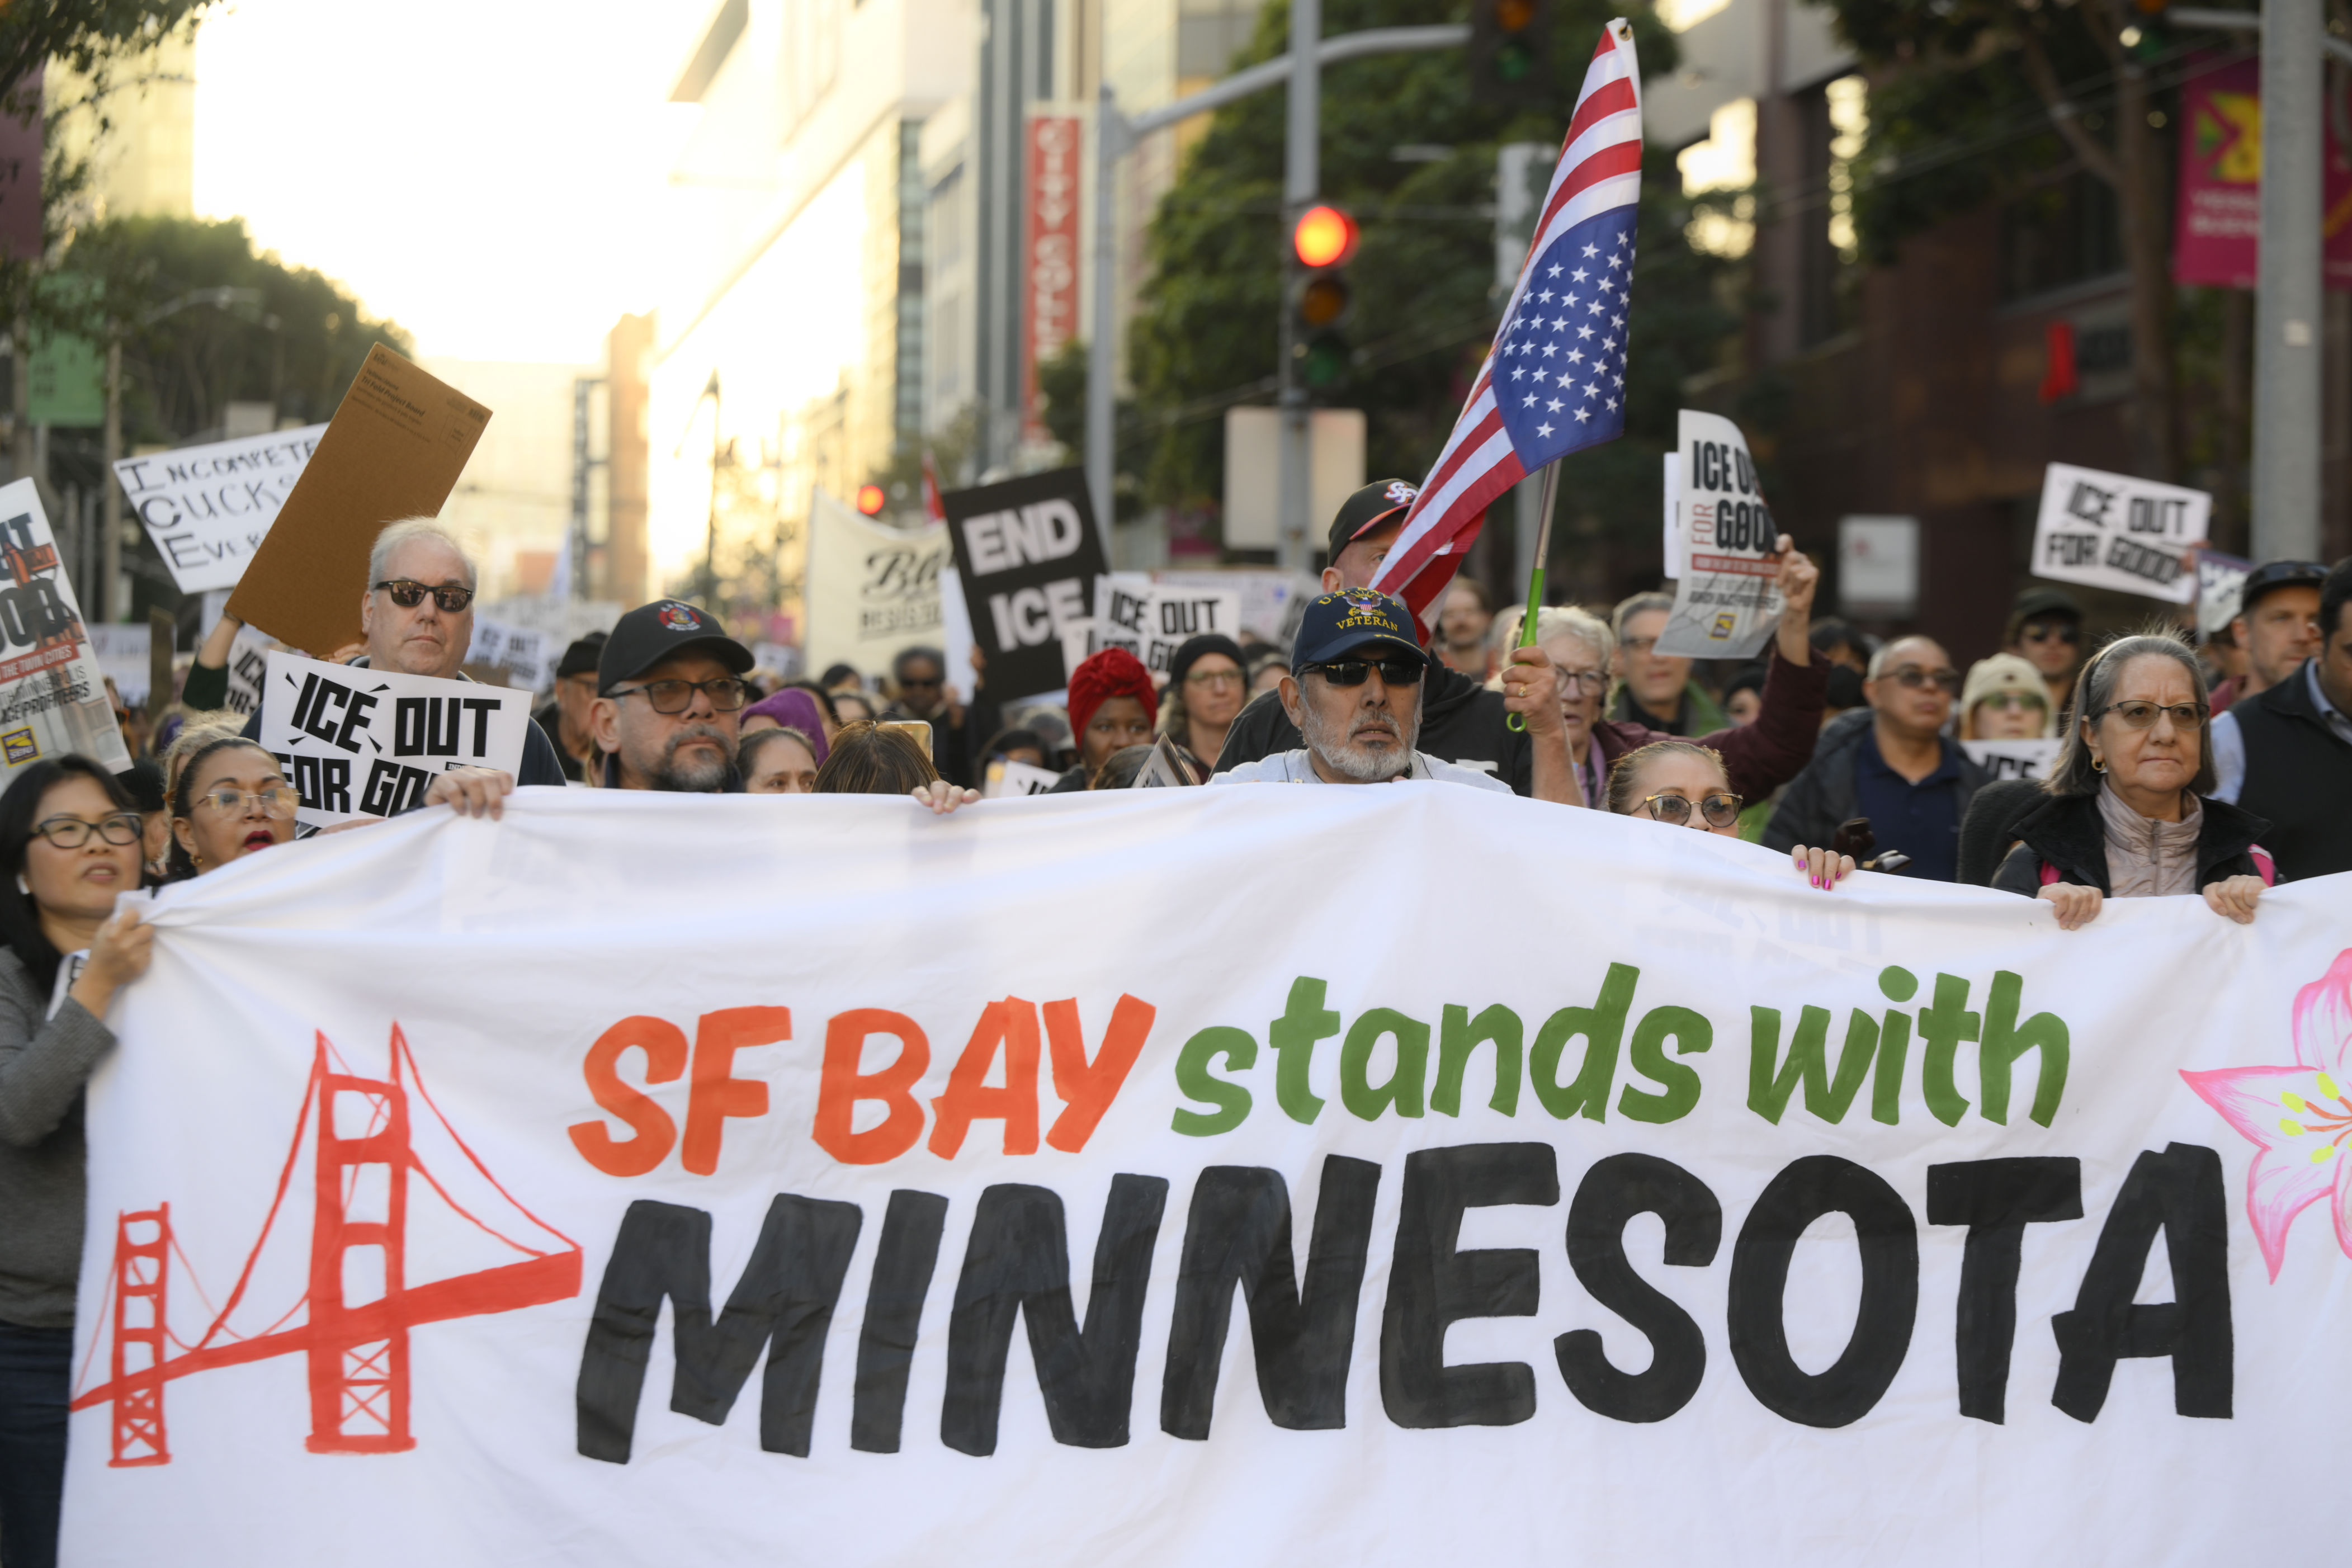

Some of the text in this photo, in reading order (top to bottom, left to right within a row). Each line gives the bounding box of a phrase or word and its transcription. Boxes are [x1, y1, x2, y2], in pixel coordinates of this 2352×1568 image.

[369, 380, 385, 394] Fold
[381, 388, 407, 408] Project
[405, 401, 426, 417] Board
[119, 438, 317, 494] INCOMPETE
[1693, 440, 1732, 492] ICE
[1383, 481, 1418, 505] SF
[2067, 481, 2189, 535] ICE OUT
[961, 498, 1083, 577] END
[1692, 503, 1715, 545] FOR
[2047, 533, 2099, 566] FOR
[988, 577, 1086, 654] ICE
[1110, 589, 1221, 635] ICE OUT
[1336, 616, 1398, 631] VETERAN
[291, 672, 501, 757] ICE OUT
[568, 962, 2070, 1177] SF BAY stands with
[577, 1141, 2234, 1465] MINNESOTA
